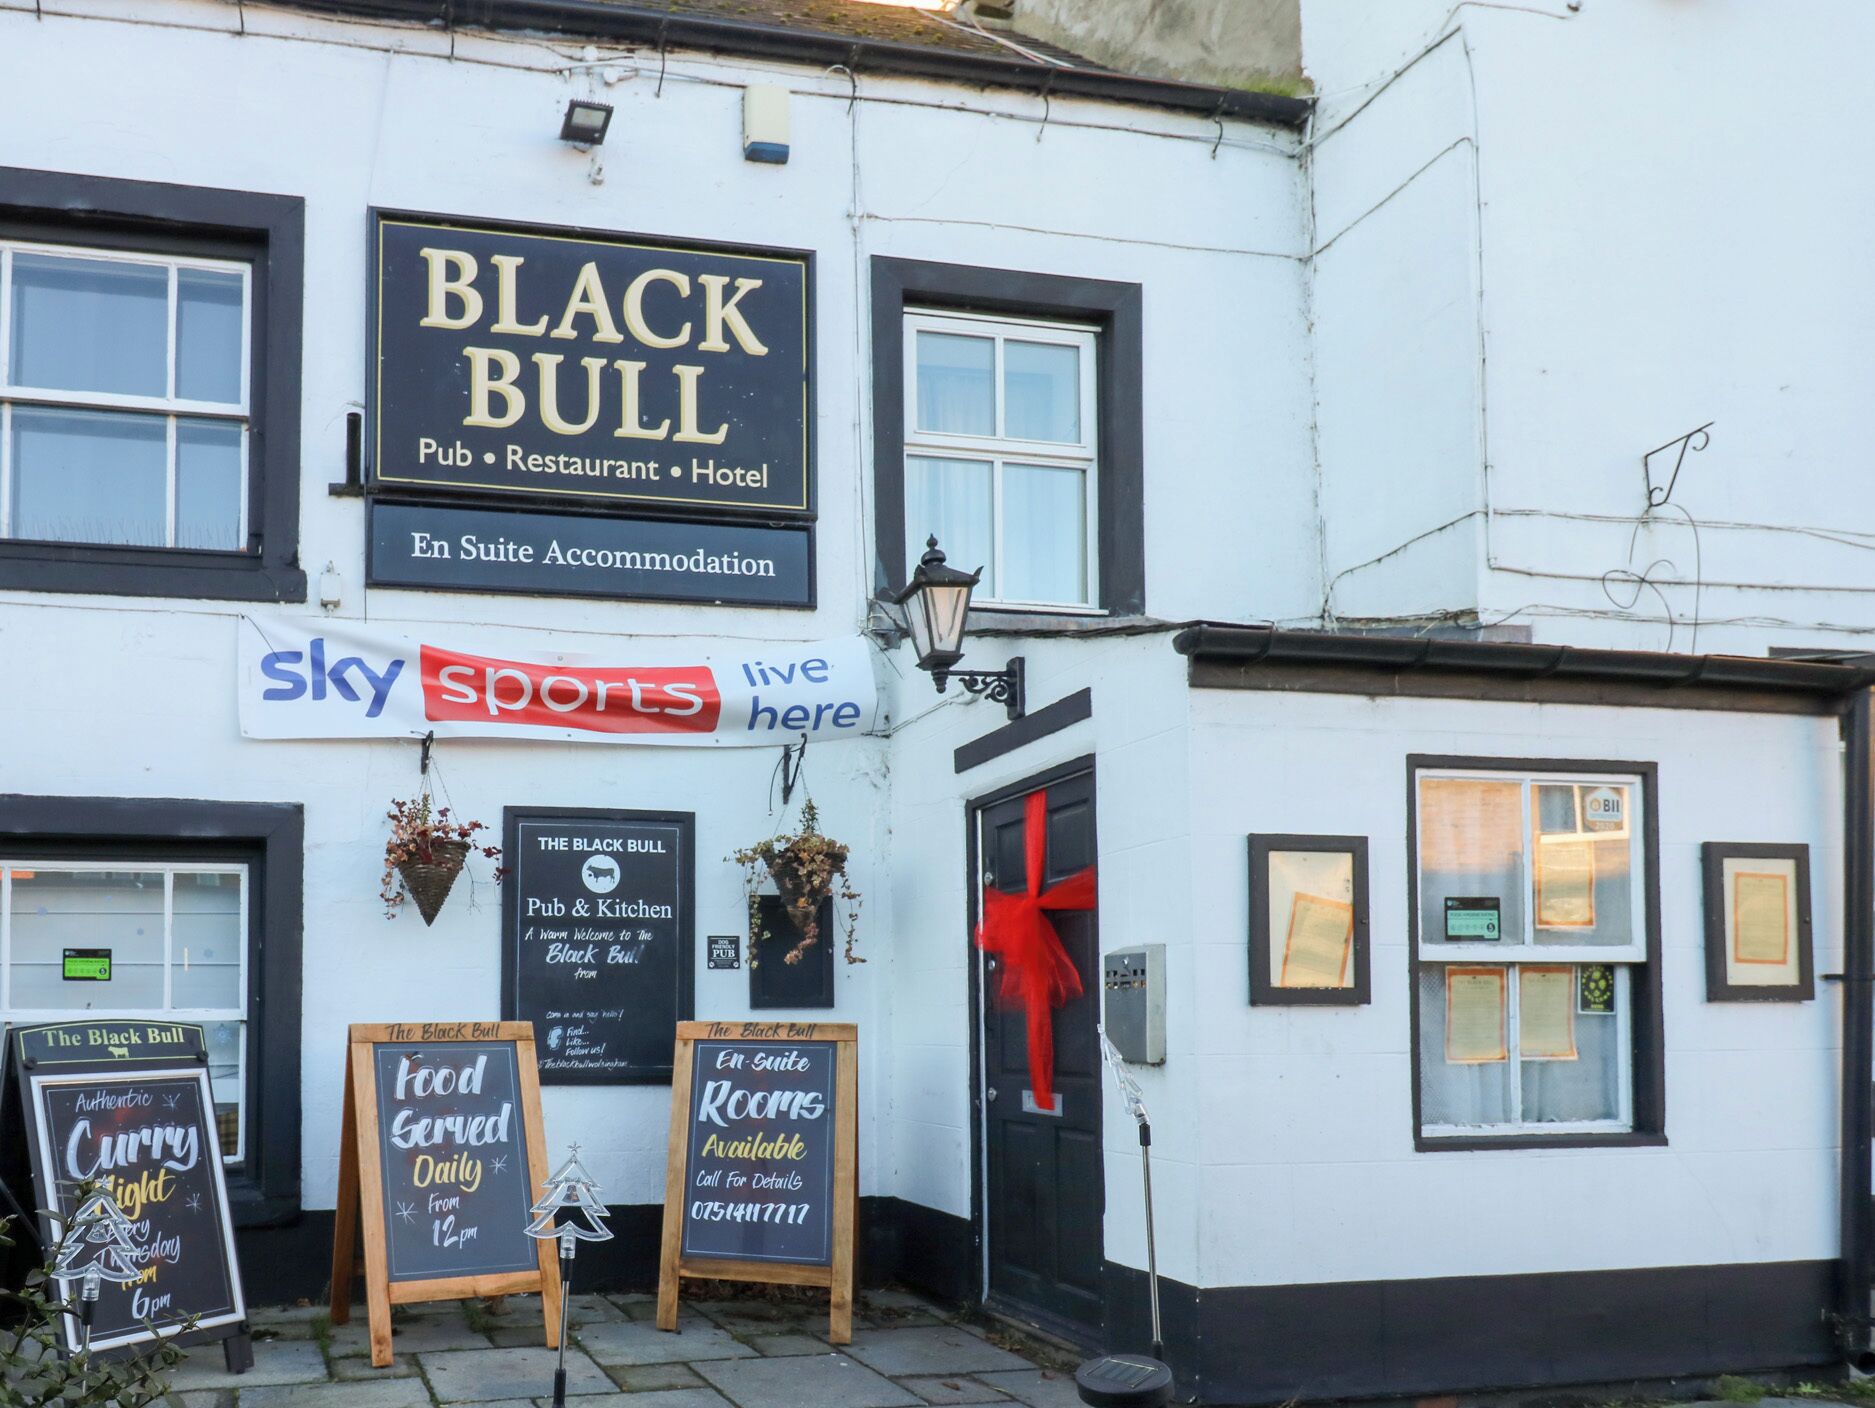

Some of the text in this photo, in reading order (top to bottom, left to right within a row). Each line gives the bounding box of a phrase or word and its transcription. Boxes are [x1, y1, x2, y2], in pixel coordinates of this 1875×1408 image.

[419, 246, 769, 356] BLACK
[462, 345, 729, 445] BULL
[418, 437, 768, 488] Pub Restaurant Hotel
[411, 532, 776, 577] En Suite Accommodation
[261, 638, 704, 718] sky sports
[742, 655, 830, 688] live
[747, 695, 862, 731] here
[538, 837, 666, 853] THE BLACK BULL
[526, 897, 673, 919] Pub & Kitchen
[525, 927, 533, 941] A
[540, 928, 568, 940] Warm
[573, 927, 615, 941] Welcome
[619, 929, 632, 941] to
[546, 942, 600, 964] Black
[712, 949, 736, 958] PUB
[42, 1027, 185, 1047] The Black Bull
[385, 1023, 500, 1041] The Black Bull
[705, 1022, 818, 1040] The Black Bull
[396, 1054, 488, 1100] Food
[75, 1088, 154, 1113] Authentic
[698, 1079, 826, 1128] Rooms
[390, 1102, 512, 1149] Served
[66, 1119, 199, 1180] Curry
[701, 1132, 808, 1161] Available
[413, 1151, 482, 1193] Daily
[696, 1169, 803, 1191] Call For Details
[428, 1193, 460, 1214] From
[691, 1201, 810, 1225] 07514117717
